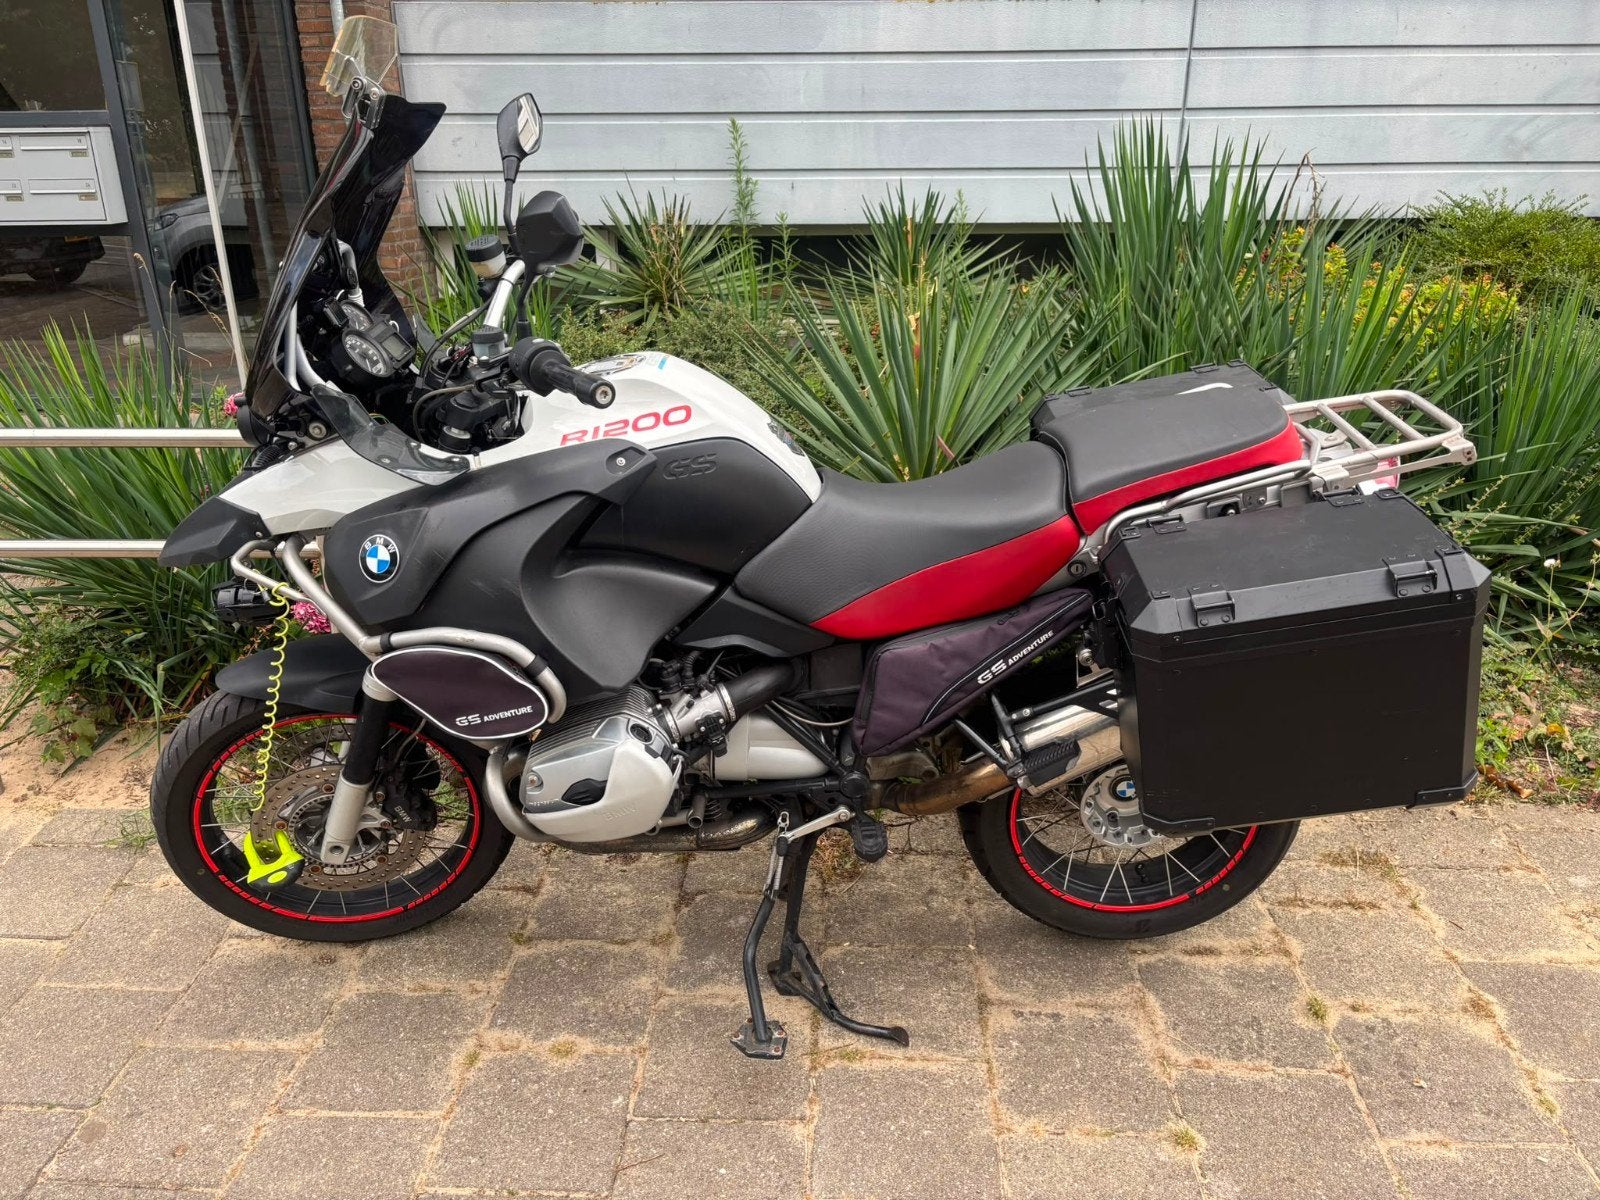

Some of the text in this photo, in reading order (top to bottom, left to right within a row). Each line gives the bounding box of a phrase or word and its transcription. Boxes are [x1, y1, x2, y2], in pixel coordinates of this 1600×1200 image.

[560, 405, 692, 446] R1200
[663, 453, 718, 480] GS
[364, 537, 396, 553] BMW
[977, 630, 1054, 684] GS ADVENTURE
[455, 705, 533, 726] GS ADVENTURE
[394, 805, 412, 823] BMW
